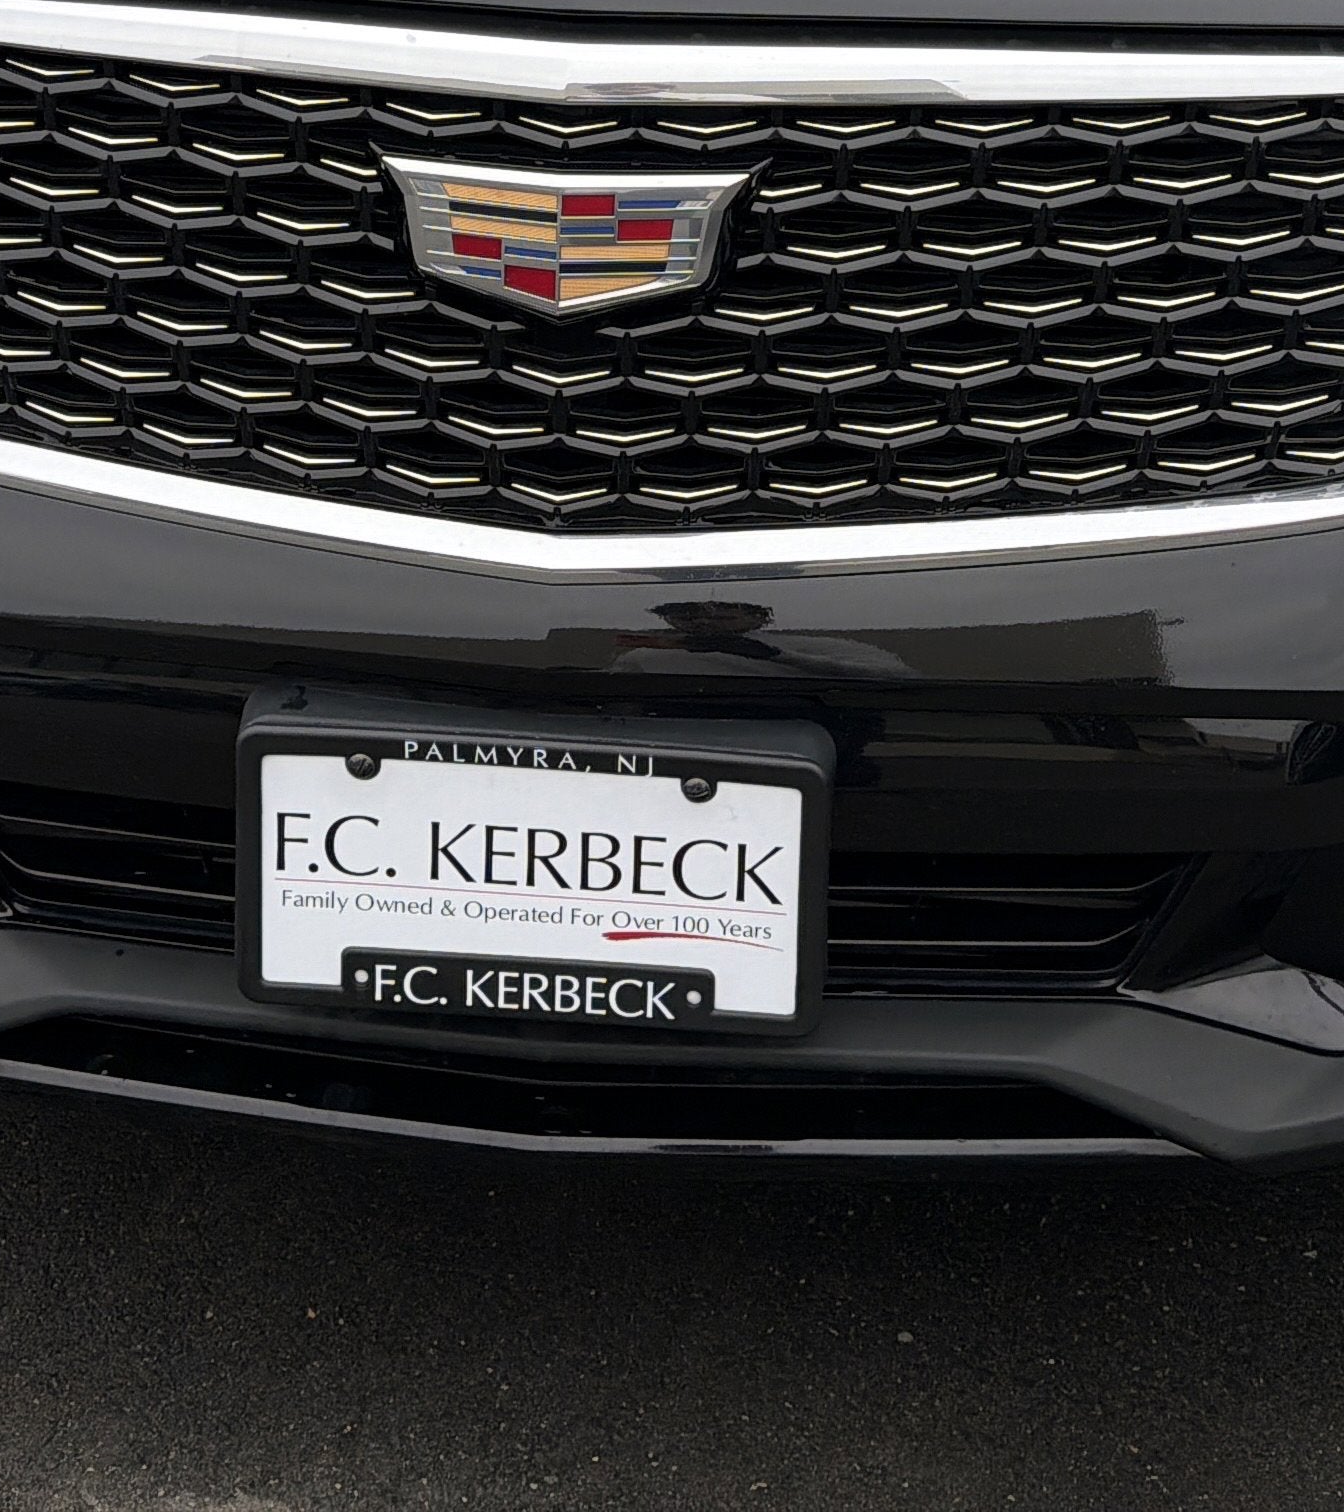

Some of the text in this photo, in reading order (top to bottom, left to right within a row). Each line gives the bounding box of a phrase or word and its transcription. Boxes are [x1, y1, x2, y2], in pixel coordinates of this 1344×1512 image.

[403, 740, 656, 777] PALMYRA, NJ
[274, 811, 784, 906] F.C. KERBECK
[281, 889, 773, 940] Family Owned & Operated For Over 100 Years
[373, 964, 677, 1020] F.C. KERBECK
